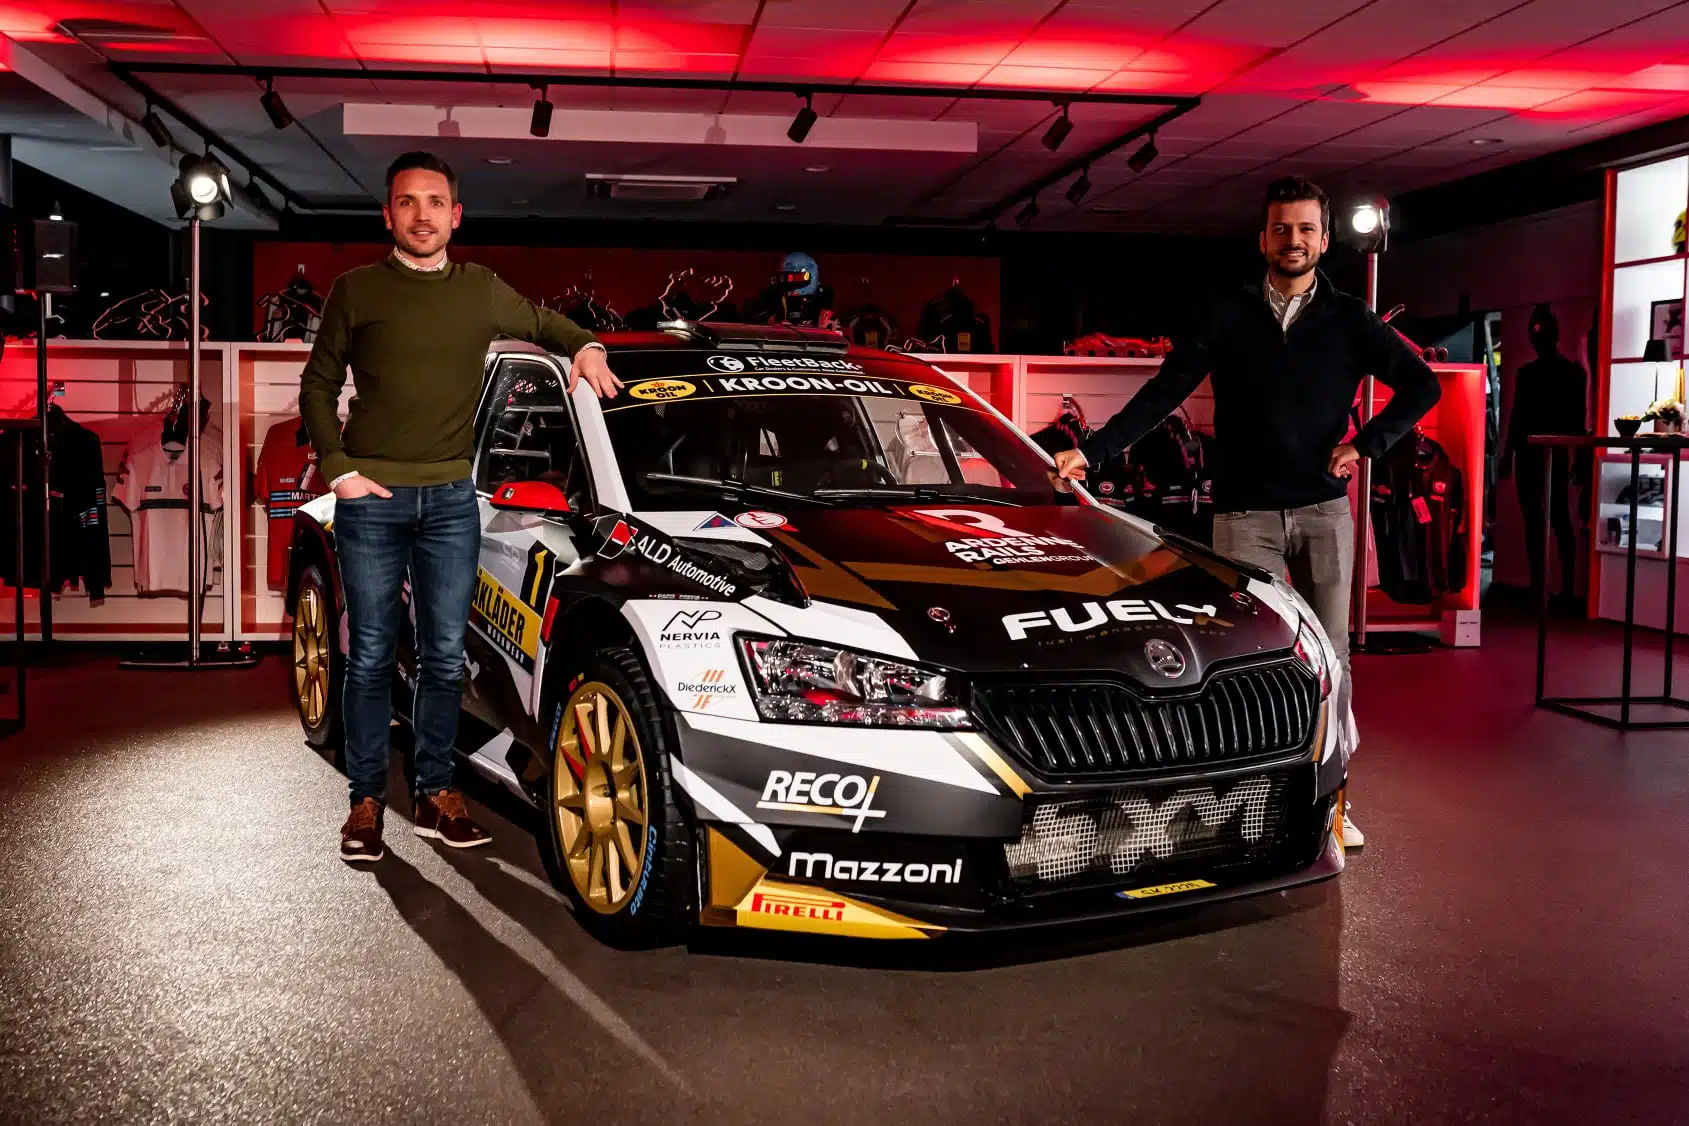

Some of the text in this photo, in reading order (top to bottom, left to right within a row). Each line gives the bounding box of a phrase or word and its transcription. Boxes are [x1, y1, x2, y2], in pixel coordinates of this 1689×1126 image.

[746, 356, 858, 371] FleetBack
[638, 385, 687, 395] KROON
[718, 377, 893, 394] KROON-OIL
[291, 492, 320, 500] MART
[955, 546, 1045, 563] RAILS
[637, 536, 736, 597] ALD Automotive
[530, 549, 548, 608] 1
[474, 569, 526, 645] ÅKLÄDER
[1002, 600, 1234, 641] FUELY
[487, 624, 525, 664] WORKWEAR
[660, 632, 720, 641] NERVIA
[677, 682, 736, 694] DiederickX
[788, 851, 963, 884] Mazzoni
[751, 893, 846, 921] PIRELLI
